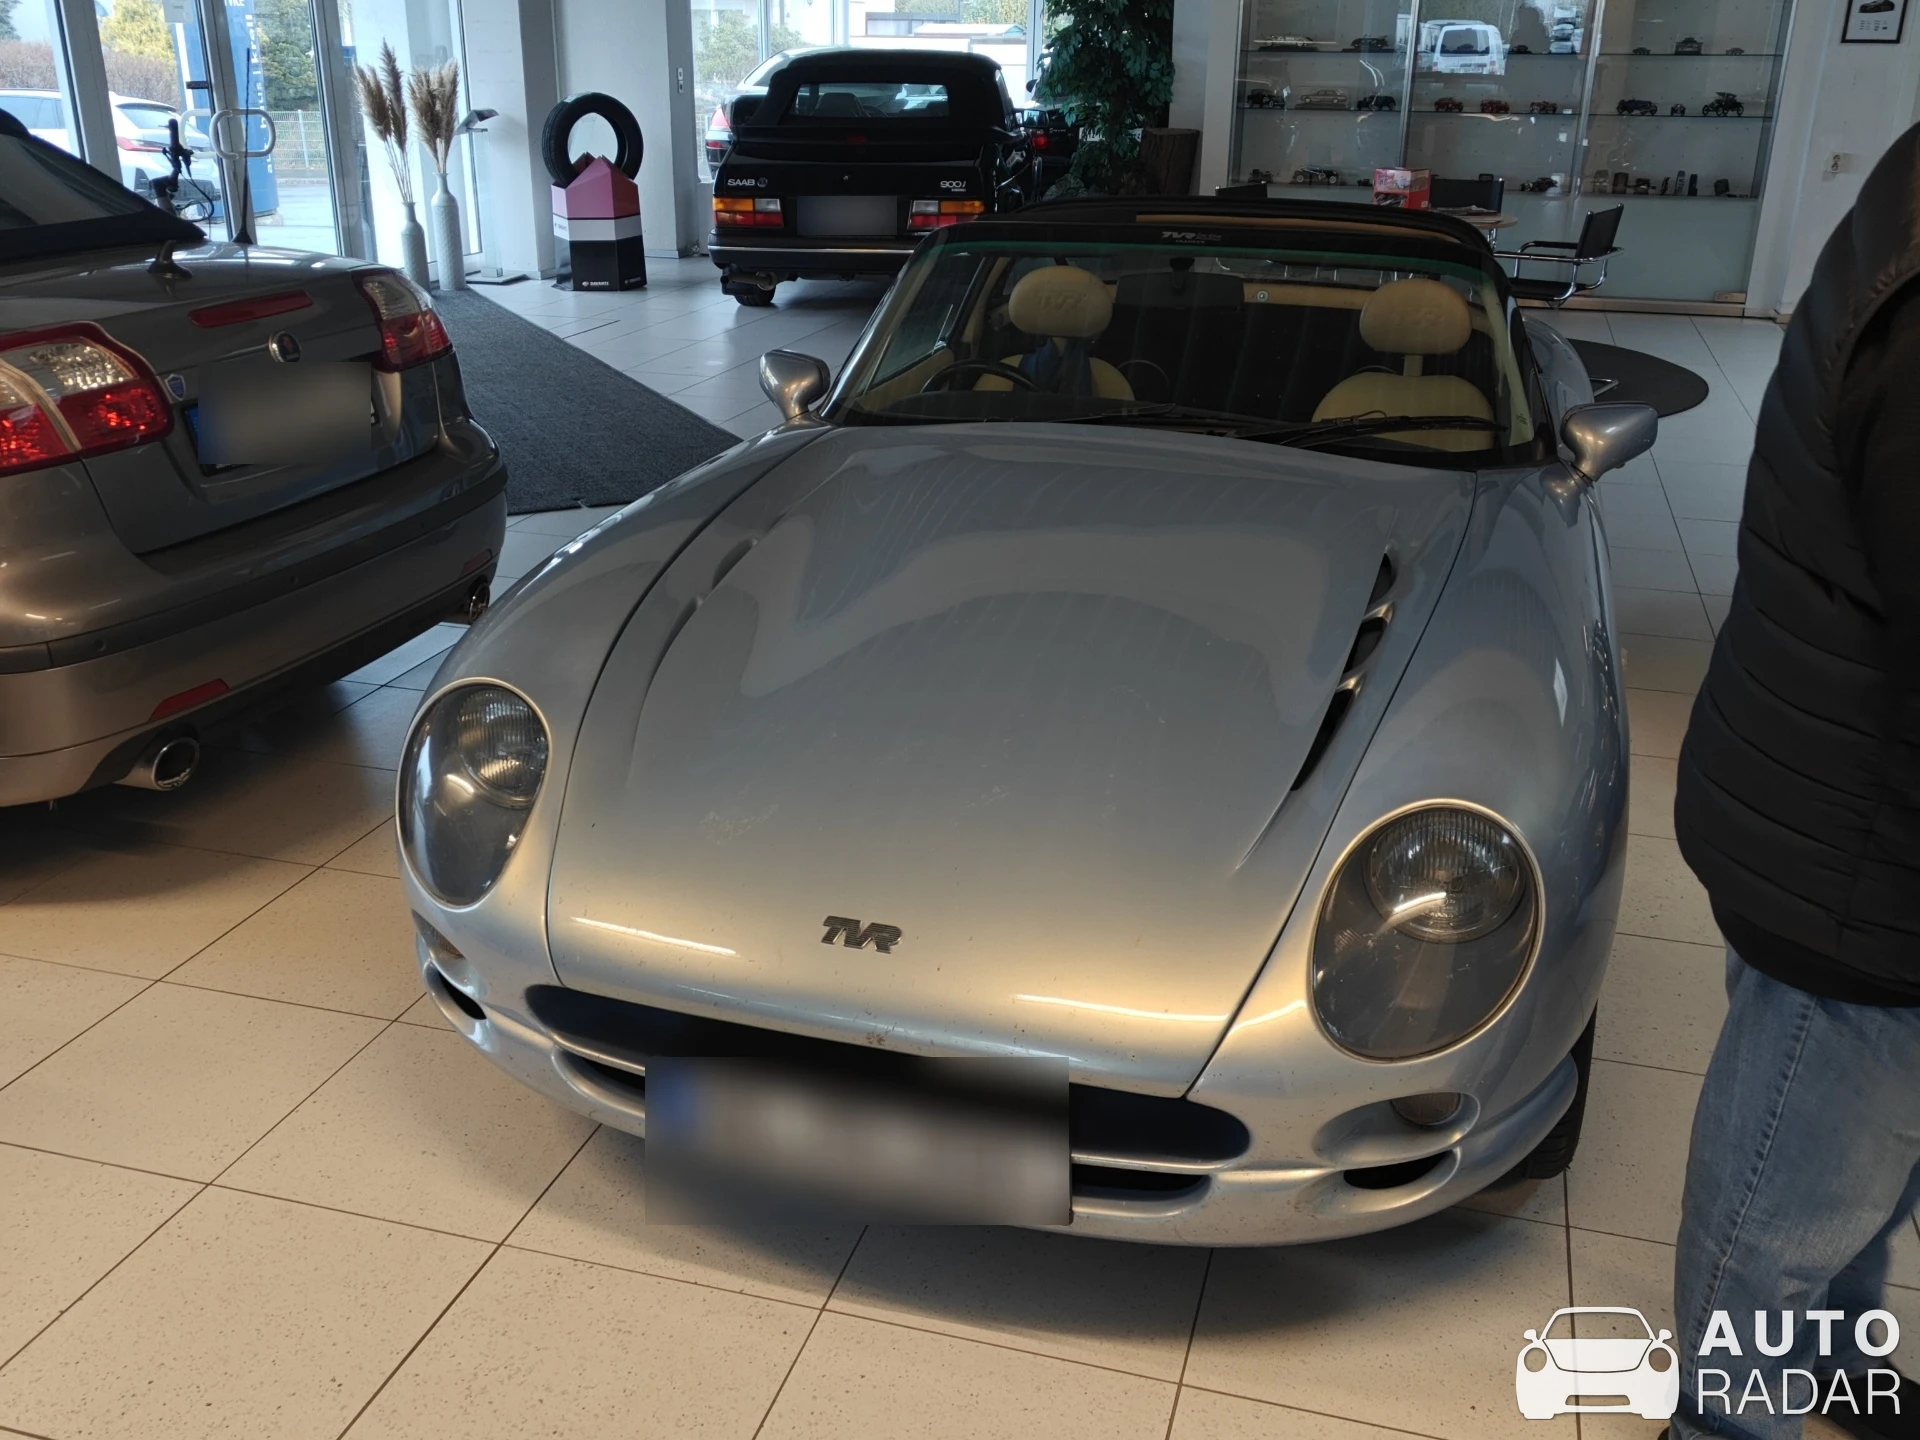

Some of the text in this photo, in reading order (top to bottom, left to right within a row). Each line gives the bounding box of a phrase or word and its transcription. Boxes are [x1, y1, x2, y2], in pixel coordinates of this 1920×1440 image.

[727, 178, 755, 186] SAAB
[1162, 231, 1197, 239] TVR
[821, 915, 902, 954] TVR
